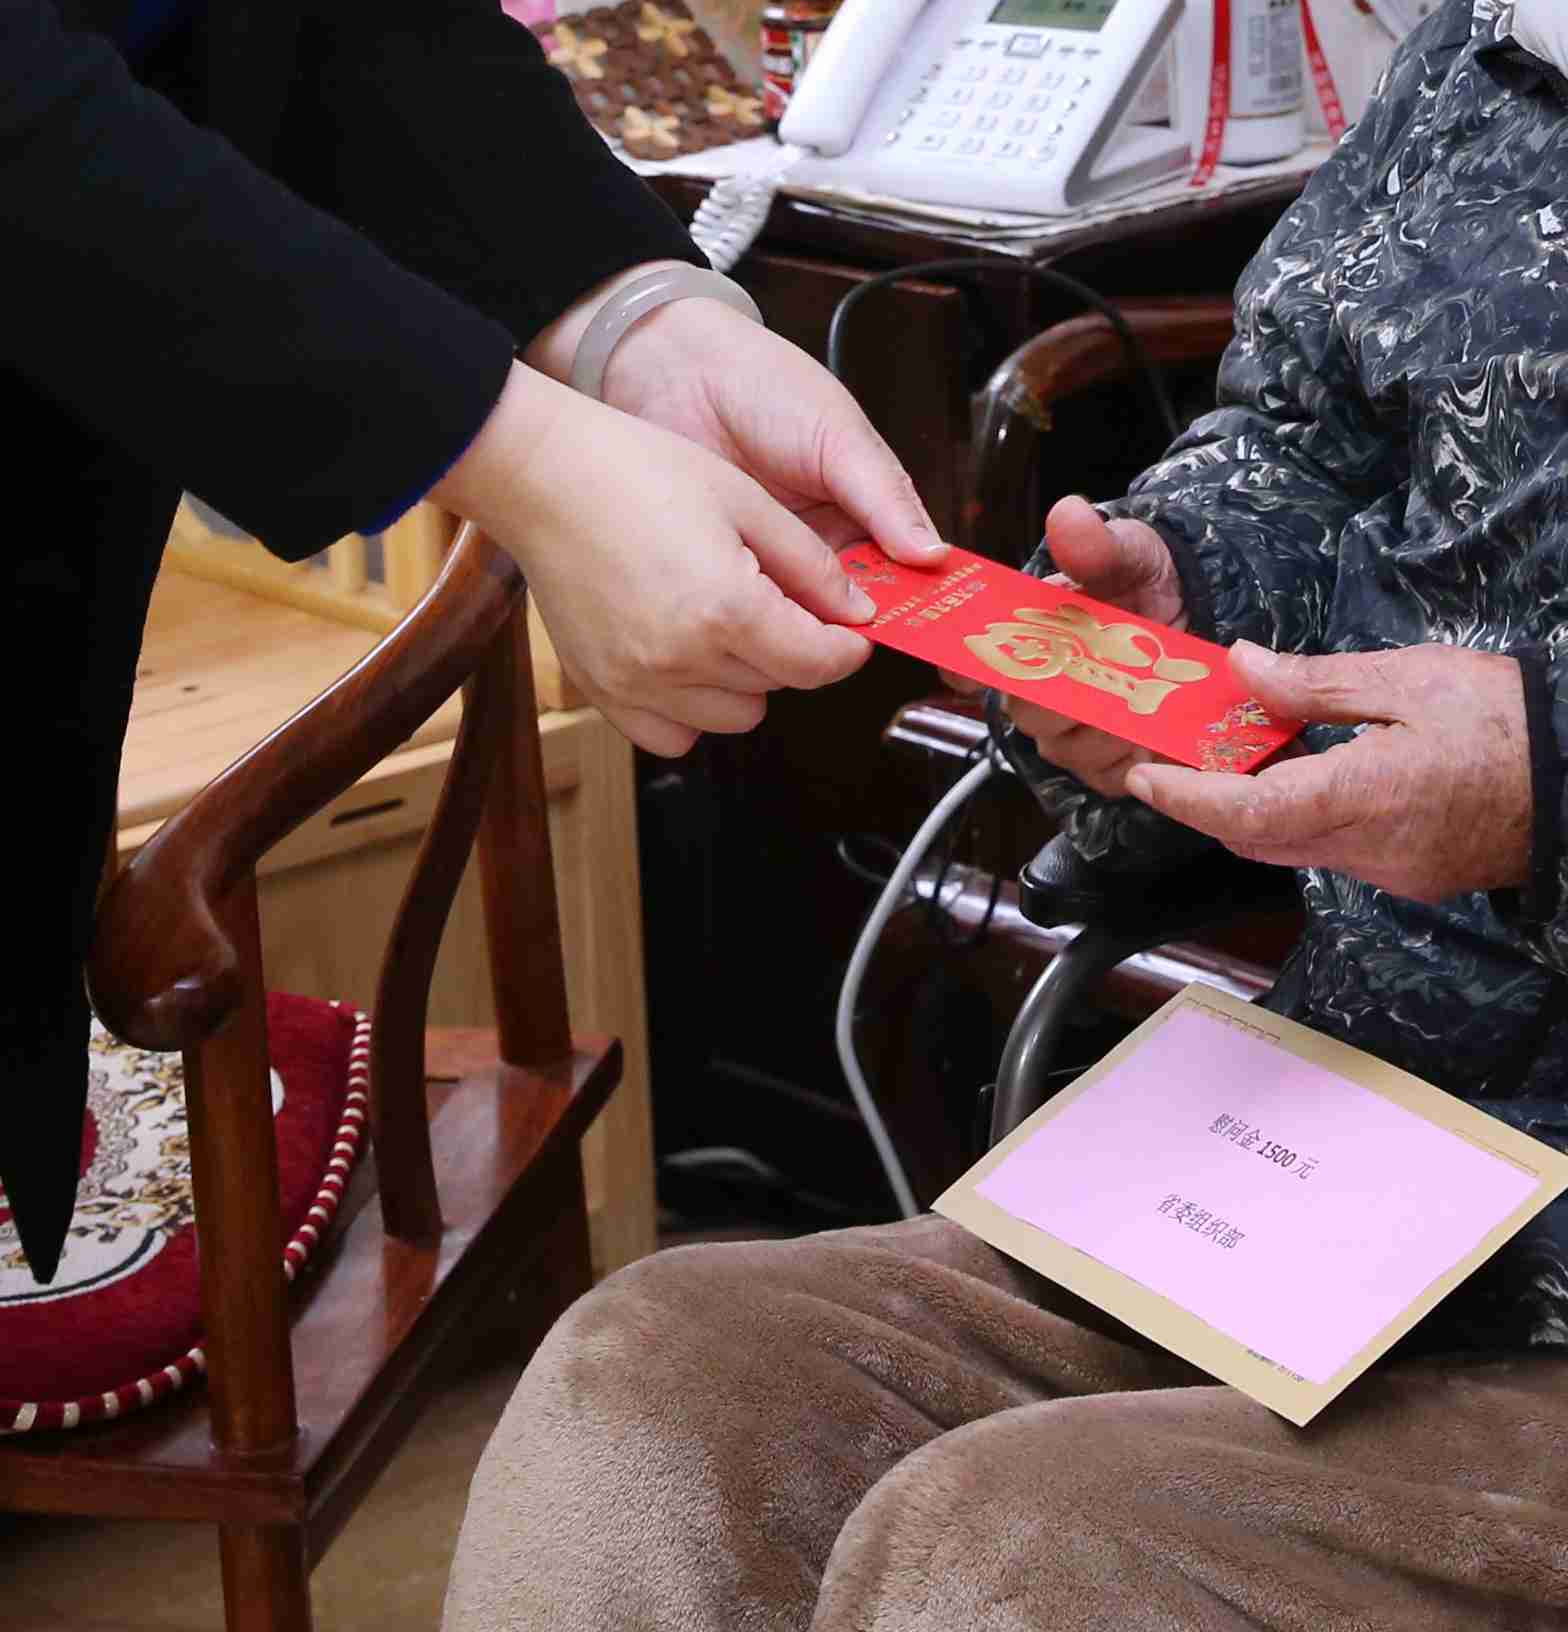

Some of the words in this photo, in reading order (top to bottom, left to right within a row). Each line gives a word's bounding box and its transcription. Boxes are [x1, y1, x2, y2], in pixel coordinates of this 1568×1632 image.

[1208, 1113, 1261, 1150] 慰问金
[1256, 1141, 1298, 1168] 1500
[1290, 1157, 1320, 1180] 元
[1158, 1193, 1246, 1248] 省委组织部
